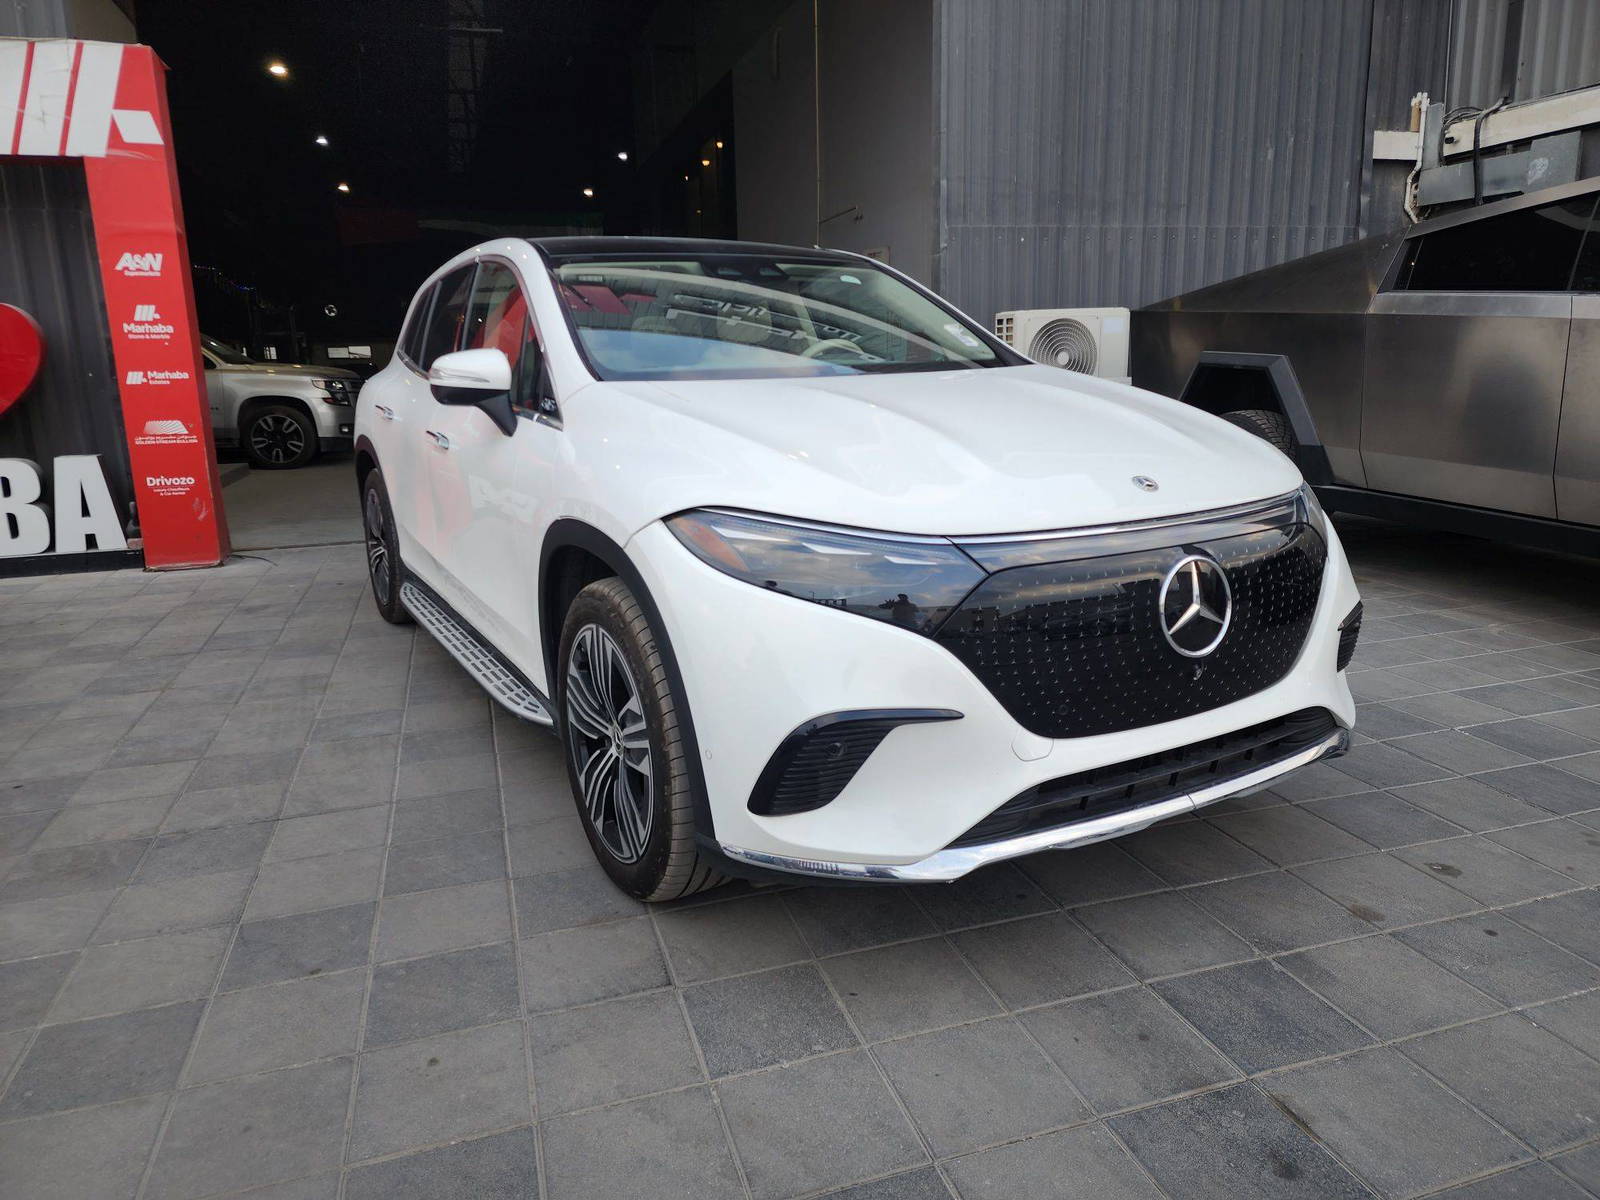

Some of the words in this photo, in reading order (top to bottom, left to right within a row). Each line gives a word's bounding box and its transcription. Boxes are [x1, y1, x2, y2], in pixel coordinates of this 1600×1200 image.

[115, 252, 163, 271] A&N
[123, 323, 174, 333] Marhaba
[147, 371, 190, 379] Marhaba
[146, 476, 195, 487] Drivozo
